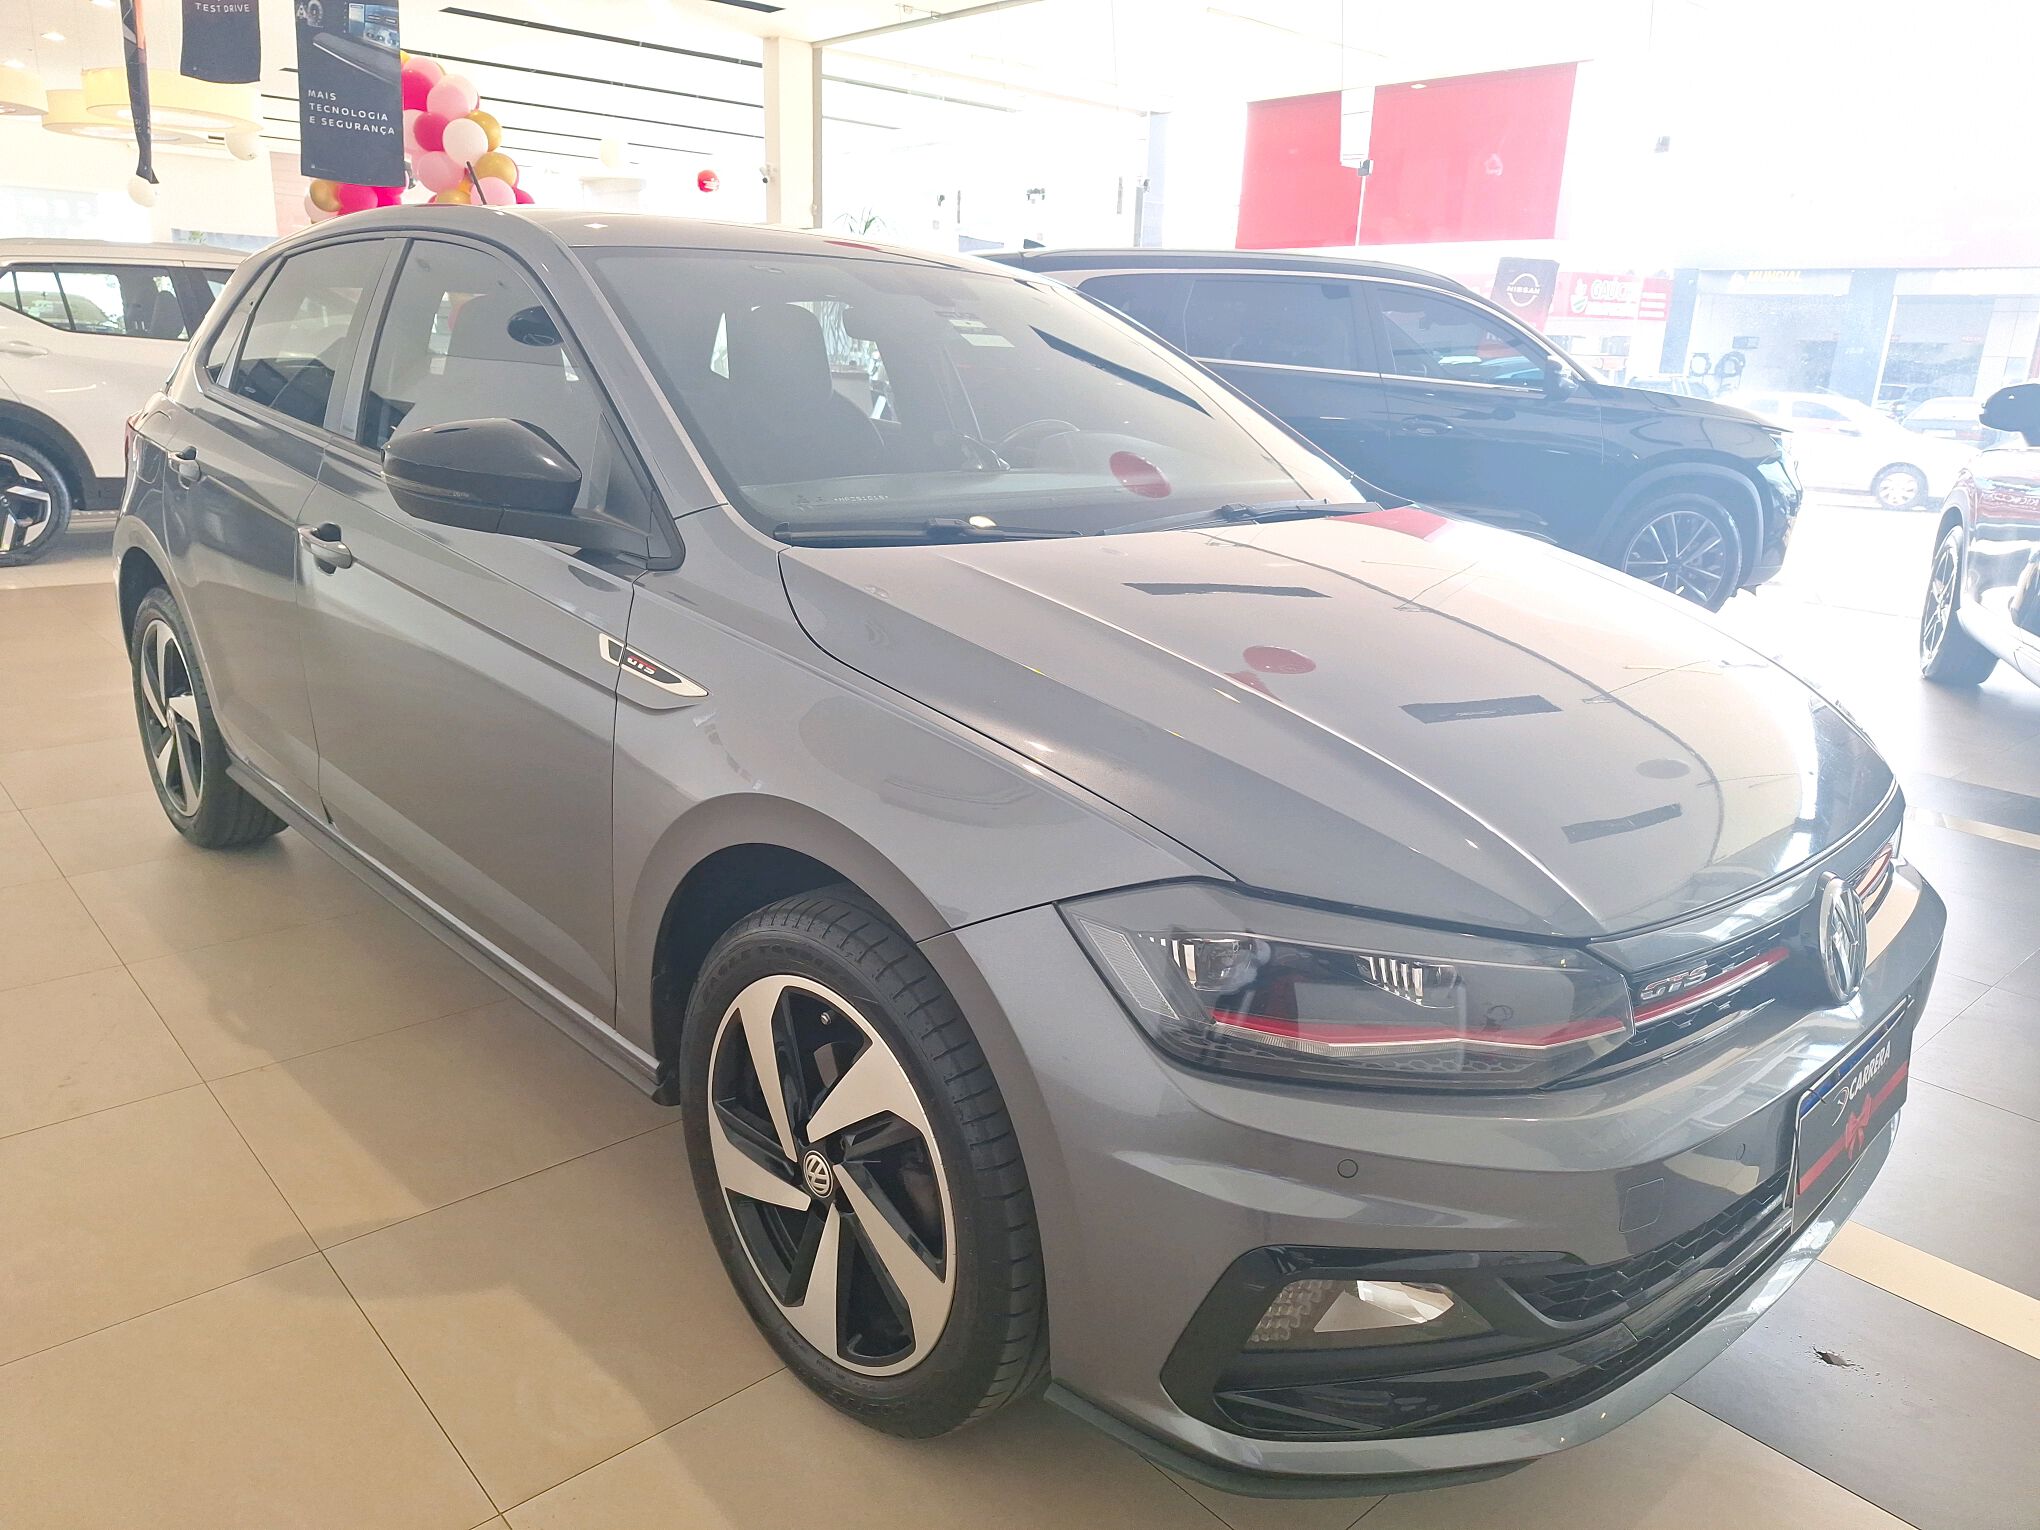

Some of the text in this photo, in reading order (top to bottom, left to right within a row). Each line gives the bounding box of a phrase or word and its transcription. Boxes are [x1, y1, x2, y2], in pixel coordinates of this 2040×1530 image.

[195, 2, 251, 14] TEST DRIVE
[308, 89, 336, 101] MAIS
[309, 102, 389, 121] TECNOLOGIA
[309, 115, 395, 135] E SEGURANÇA
[1506, 285, 1541, 295] NISSAN
[1640, 962, 1708, 1000] GTS
[1848, 1040, 1892, 1100] CARRERA
